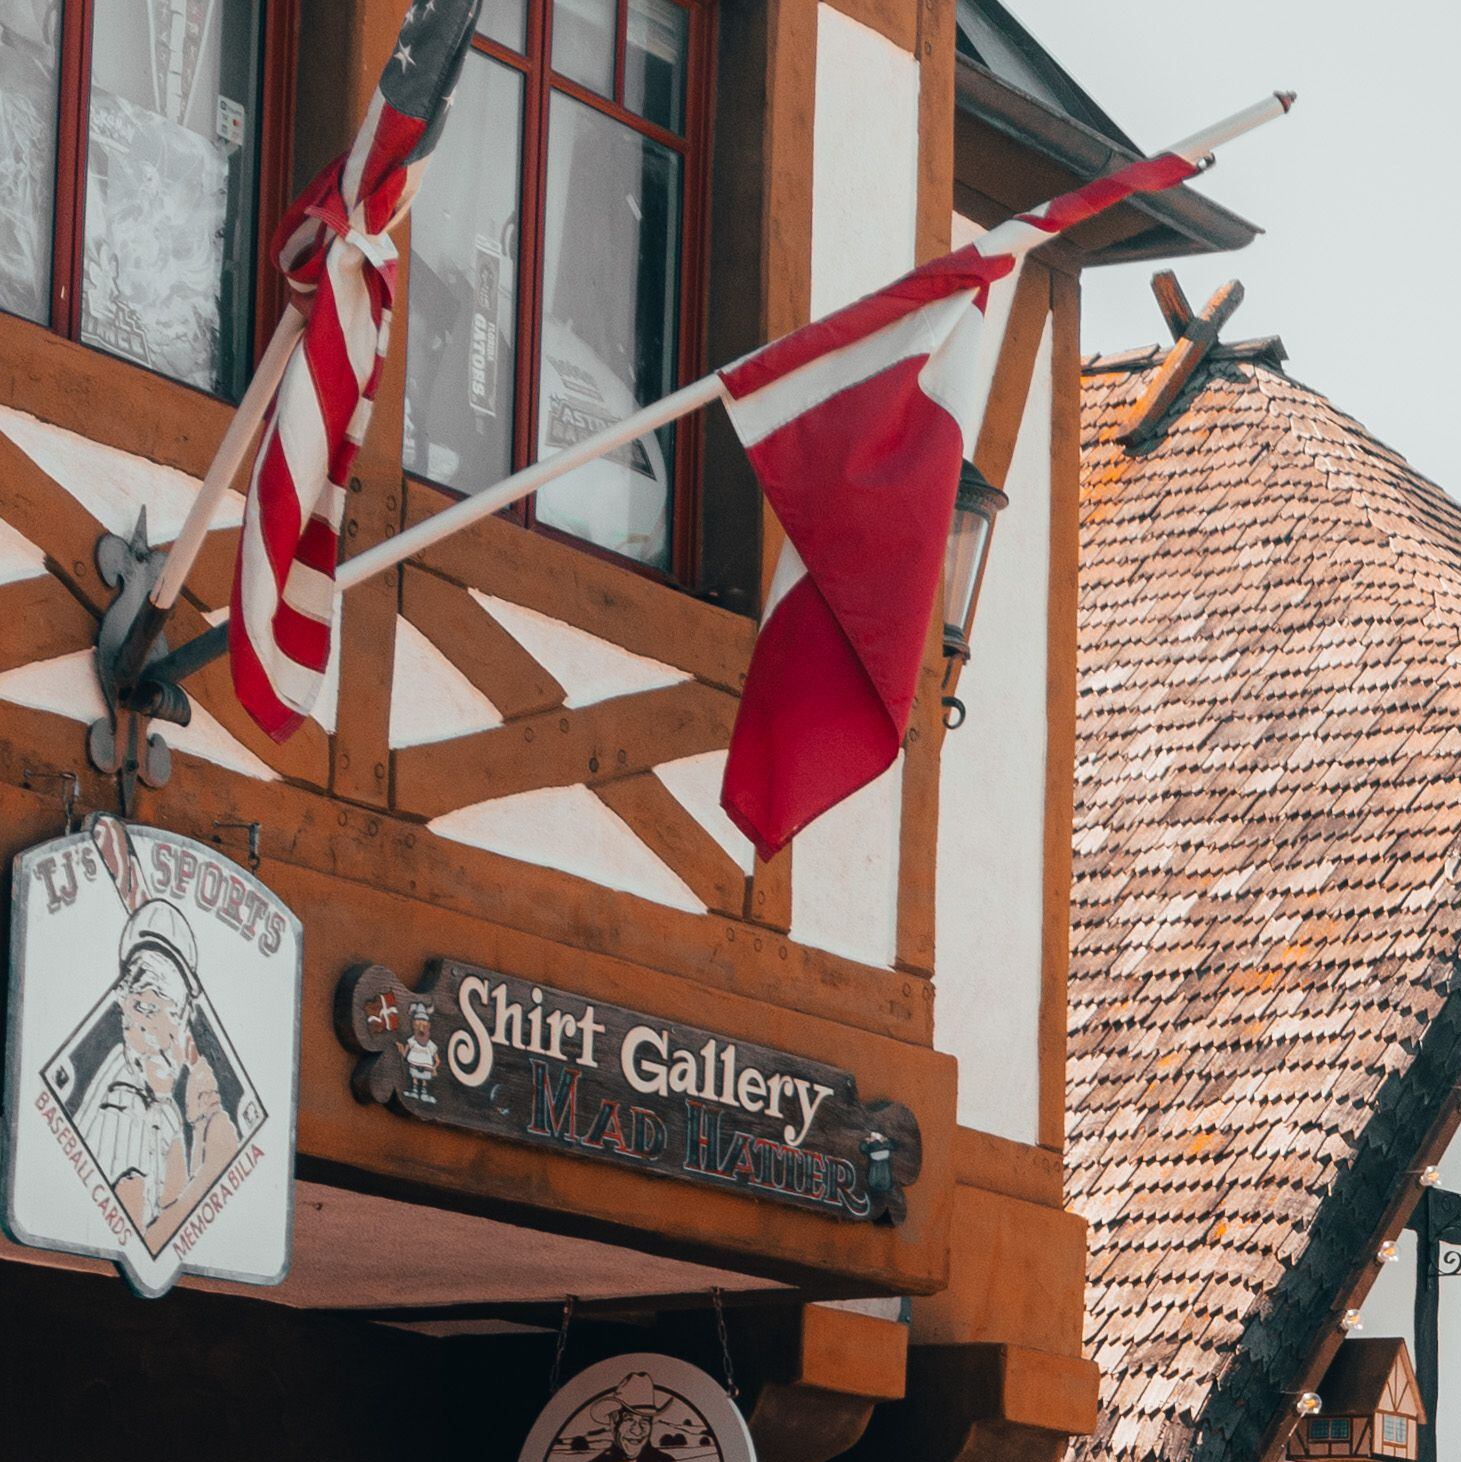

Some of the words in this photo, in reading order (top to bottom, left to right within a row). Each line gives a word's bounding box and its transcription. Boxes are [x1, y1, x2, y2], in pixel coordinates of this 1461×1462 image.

[150, 842, 288, 958] SPORTS
[447, 974, 605, 1088] Shirt
[620, 1024, 834, 1147] Gallery
[526, 1058, 668, 1162] MAD
[683, 1100, 871, 1218] HATTER
[34, 1092, 92, 1190] BASEBALL
[90, 1183, 133, 1249] CARDS
[171, 1146, 266, 1262] MEMORABILIA
